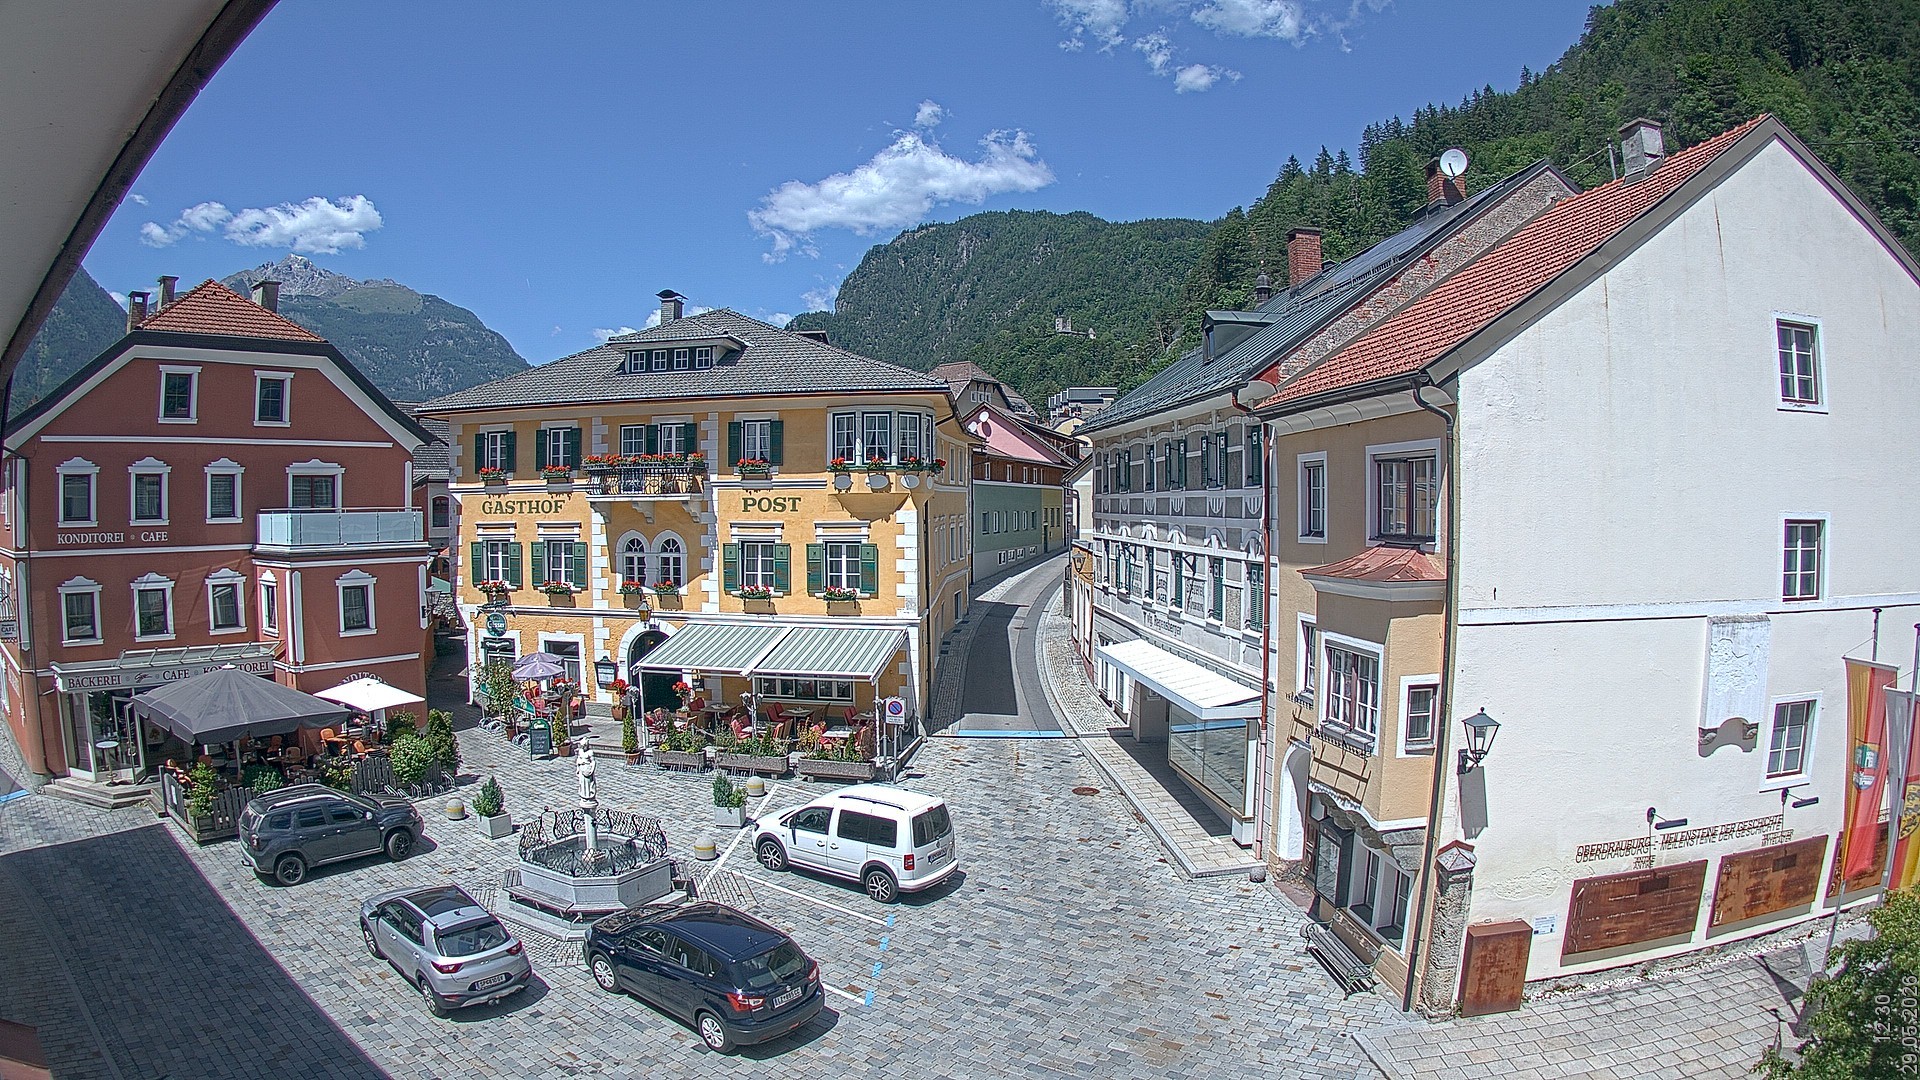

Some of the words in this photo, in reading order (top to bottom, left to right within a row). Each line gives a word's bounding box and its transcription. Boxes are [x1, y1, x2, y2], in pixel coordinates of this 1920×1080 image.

[482, 499, 566, 515] GASTHOF
[742, 497, 802, 512] POST
[57, 532, 125, 545] KONDITOREI
[141, 531, 168, 542] CAFE
[67, 675, 121, 689] BÄCKEREI
[162, 669, 190, 681] CAFE
